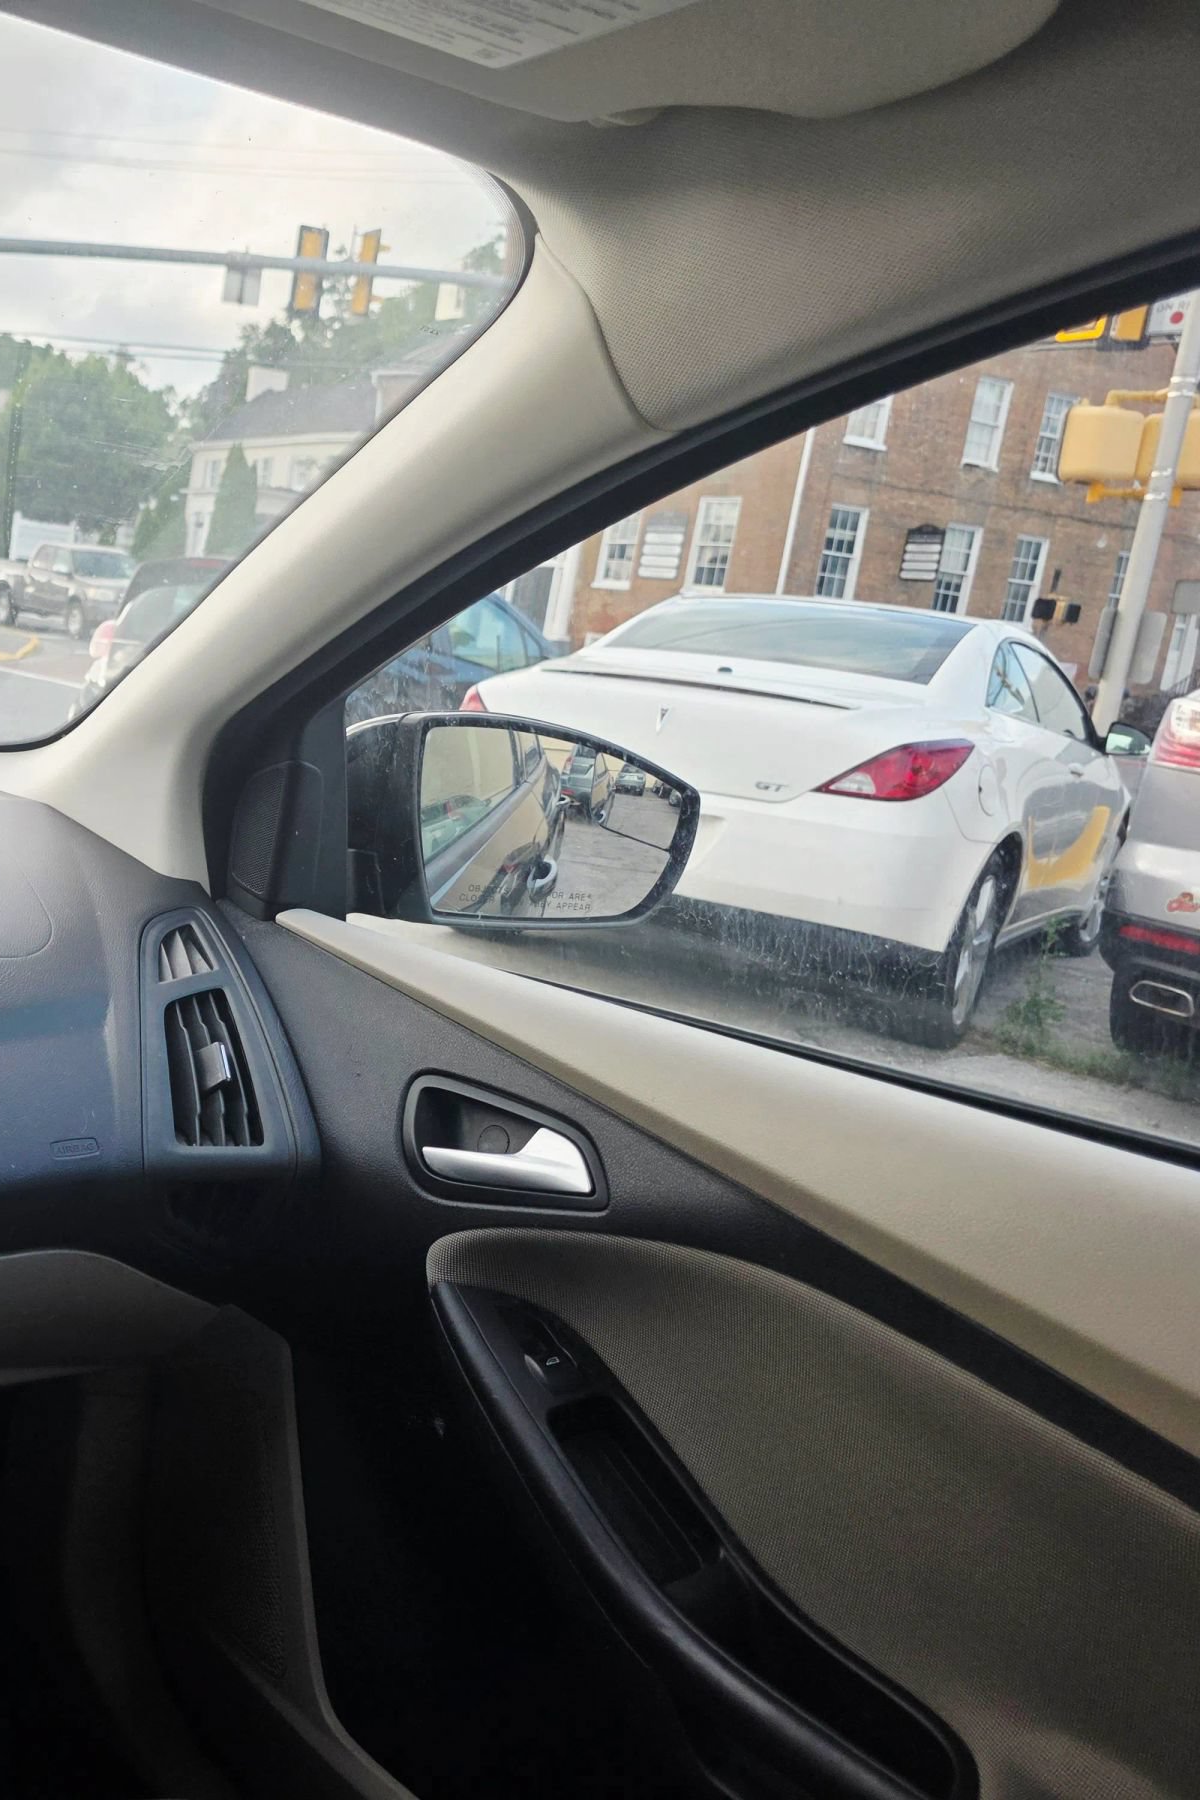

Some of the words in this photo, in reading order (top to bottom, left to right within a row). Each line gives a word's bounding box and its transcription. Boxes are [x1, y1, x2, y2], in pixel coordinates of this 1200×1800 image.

[754, 780, 790, 793] GT
[569, 892, 587, 902] ARE
[555, 903, 592, 912] APPEAR
